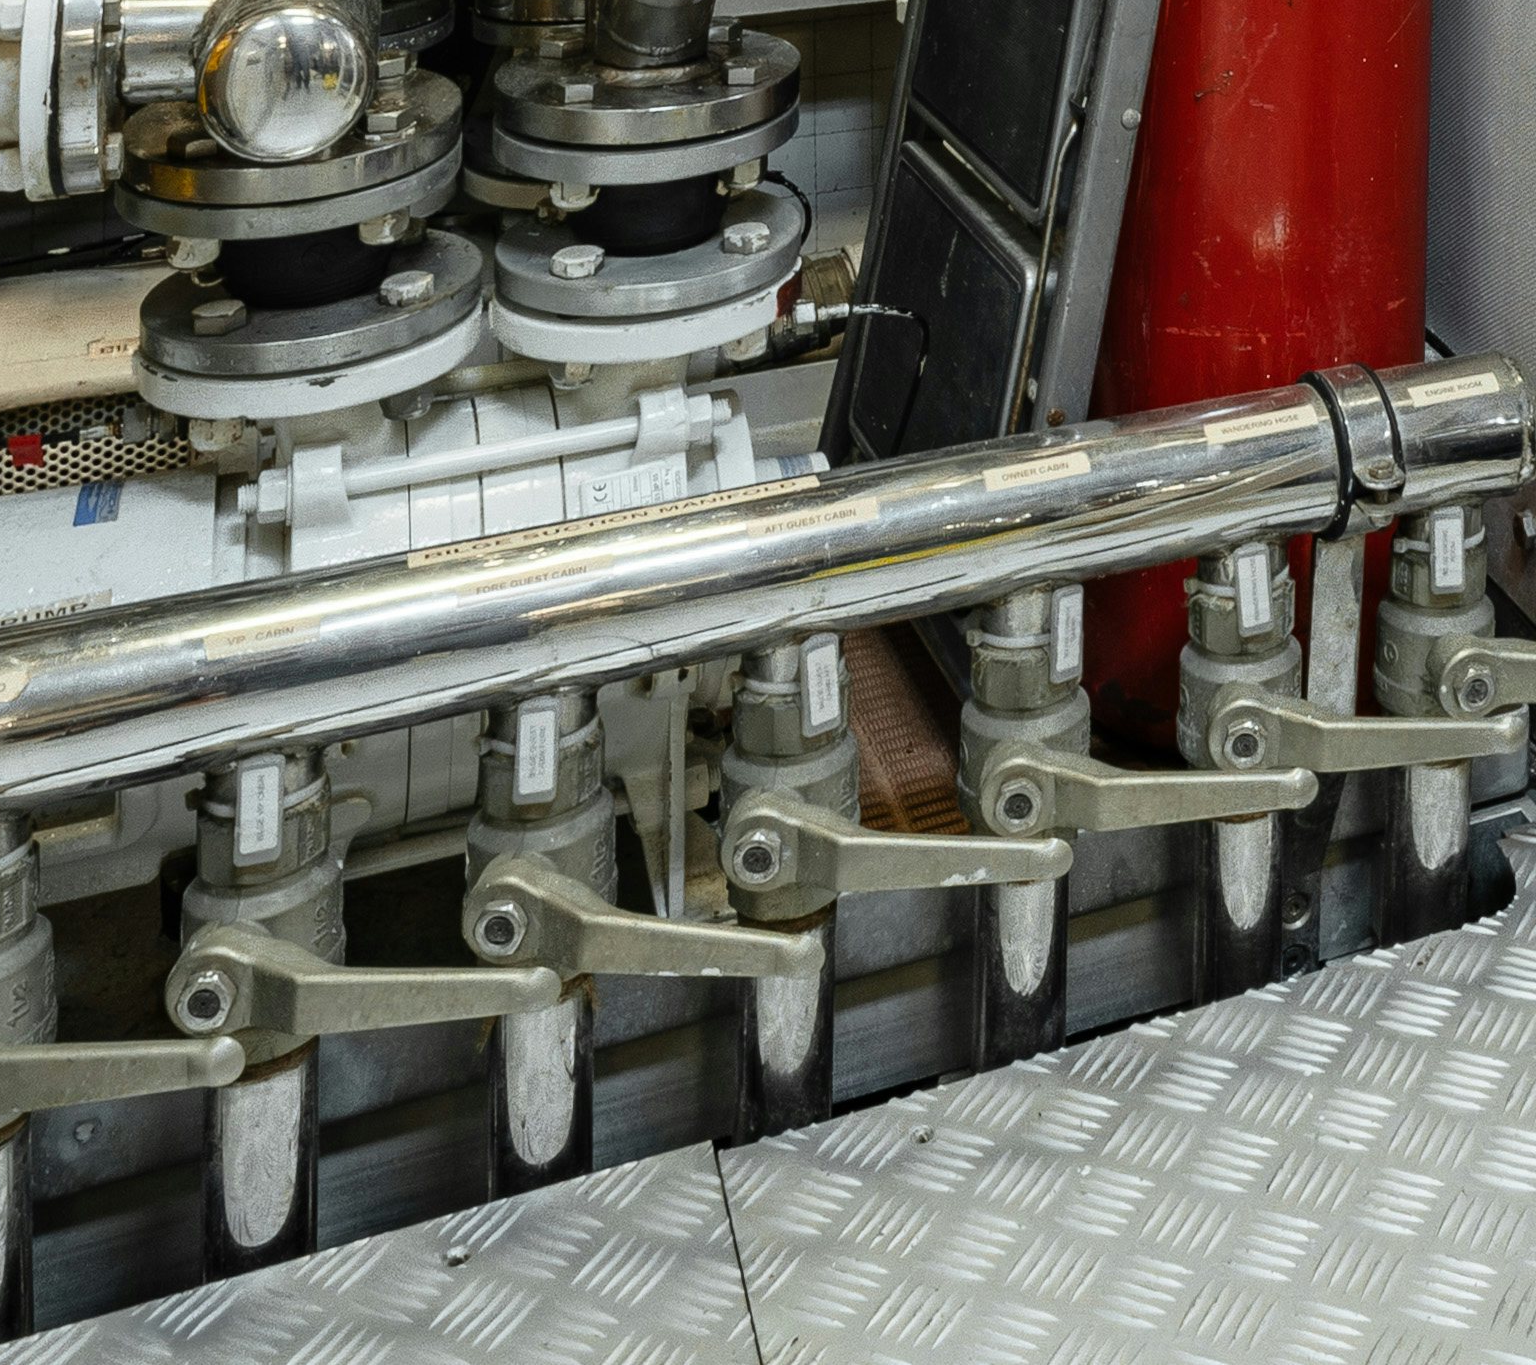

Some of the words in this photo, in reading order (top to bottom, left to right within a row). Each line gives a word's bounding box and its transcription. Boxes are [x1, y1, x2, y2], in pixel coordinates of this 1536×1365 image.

[1423, 383, 1456, 400] ENGINE
[1456, 378, 1485, 394] ROOM
[1221, 417, 1271, 437] WANDERING
[1272, 412, 1302, 428] HOSE
[1000, 467, 1036, 482] OWNER
[1037, 460, 1070, 476] CABIN
[423, 534, 506, 560] BILGE
[512, 507, 651, 541] SUCTION
[656, 480, 800, 514] MANIFOLD
[763, 520, 789, 536] AFT
[788, 513, 825, 531] GUEST
[825, 507, 859, 525] CABIN
[476, 581, 509, 596] FORE
[512, 573, 548, 591] GUEST
[549, 565, 588, 584] CABIN
[226, 634, 247, 647] VIP
[253, 624, 296, 642] CABIN
